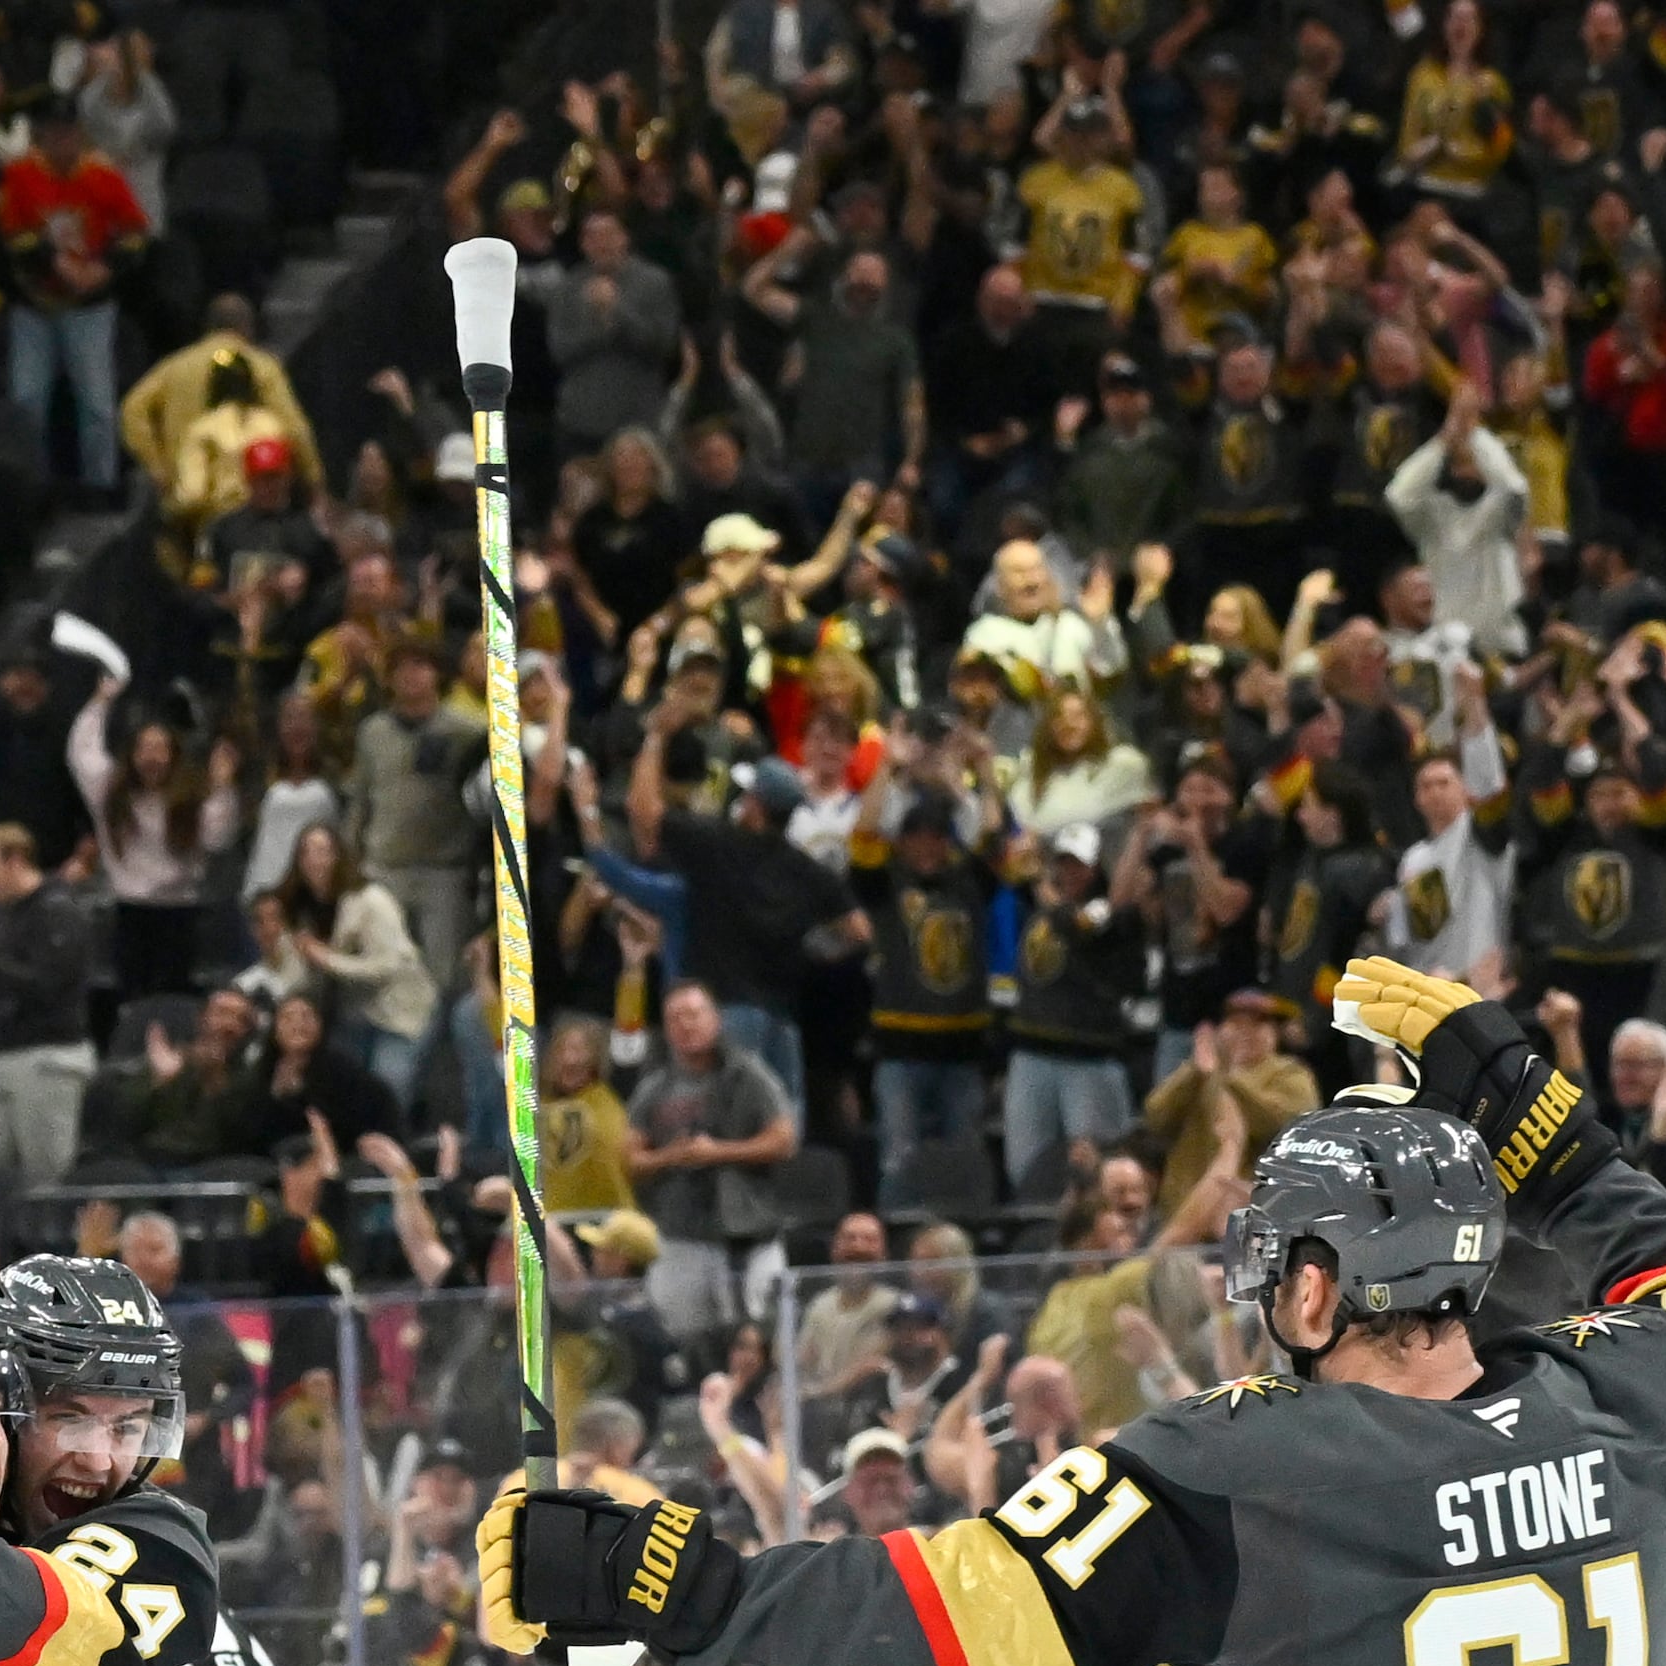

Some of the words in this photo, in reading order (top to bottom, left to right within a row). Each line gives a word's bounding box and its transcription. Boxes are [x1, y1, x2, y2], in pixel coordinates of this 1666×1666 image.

[1453, 1223, 1484, 1262] 61
[100, 1298, 145, 1326] 24
[99, 1350, 158, 1365] BAUER
[994, 1445, 1153, 1591] 61
[1435, 1449, 1612, 1568] STONE
[52, 1522, 187, 1661] 24
